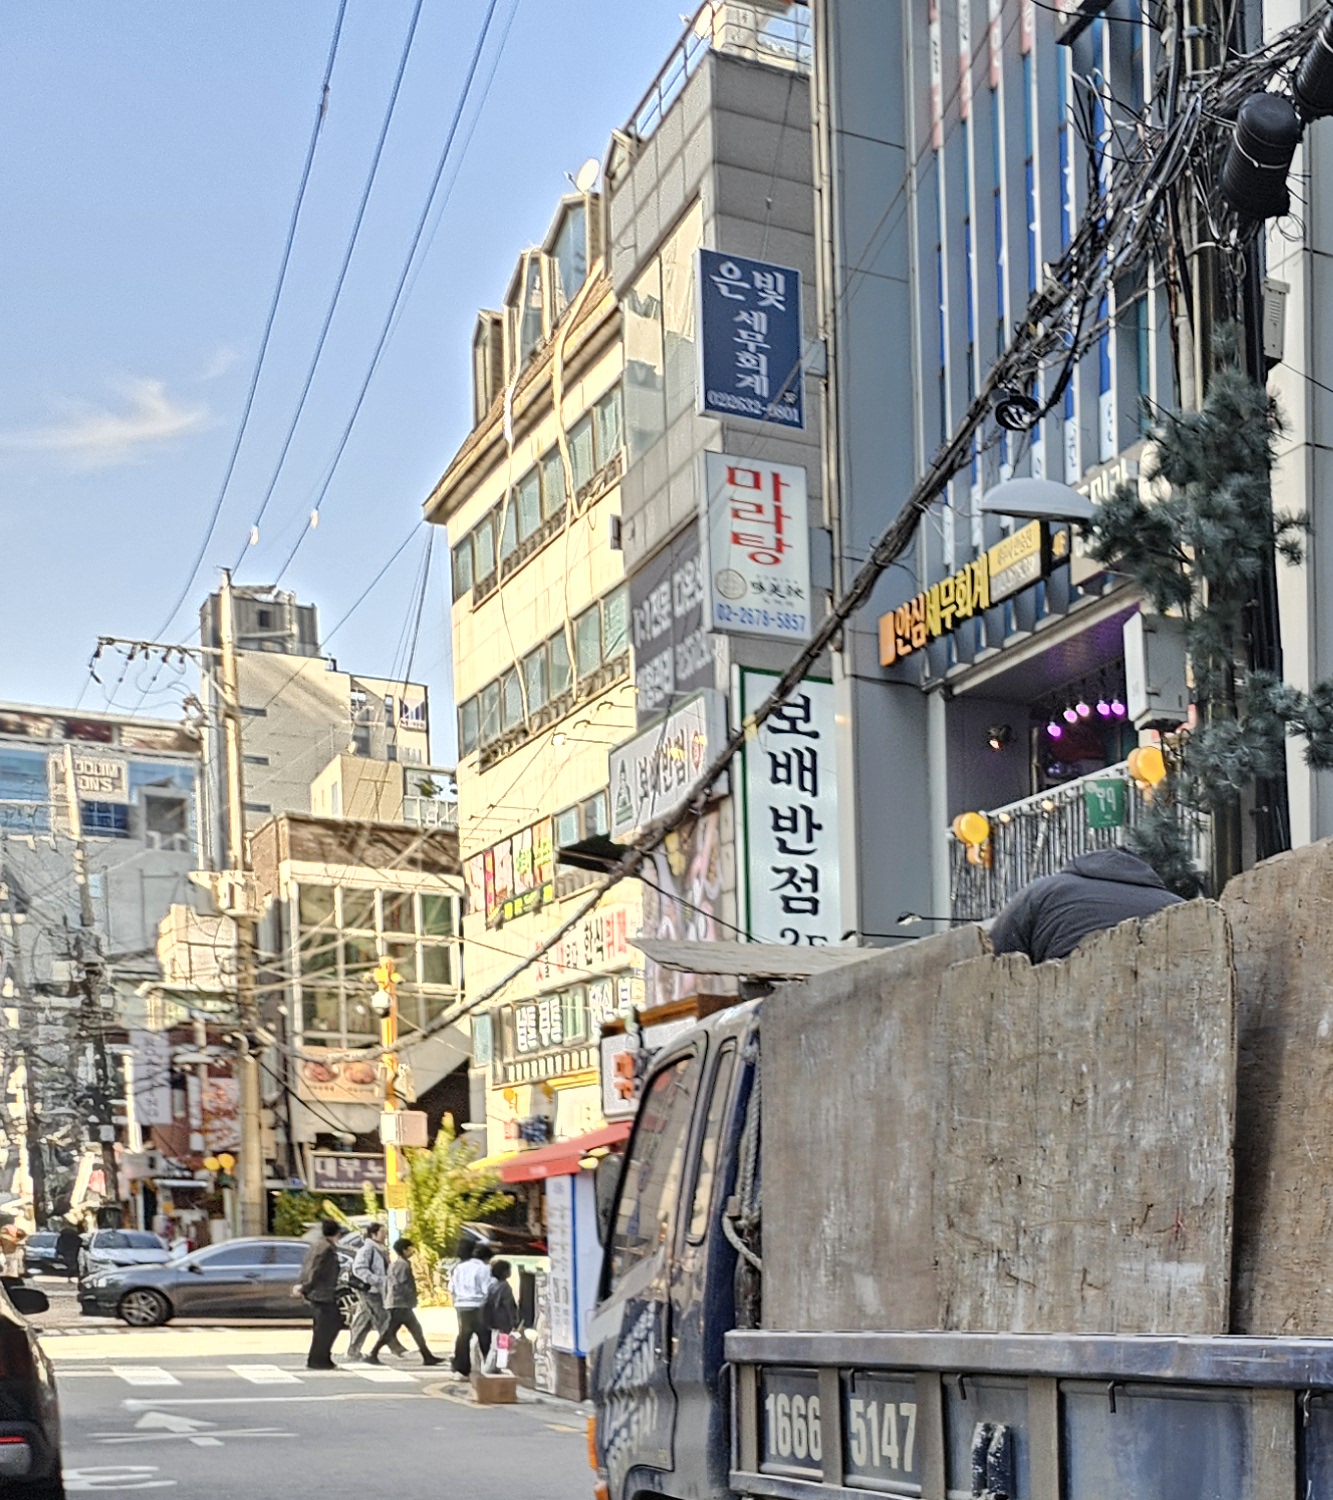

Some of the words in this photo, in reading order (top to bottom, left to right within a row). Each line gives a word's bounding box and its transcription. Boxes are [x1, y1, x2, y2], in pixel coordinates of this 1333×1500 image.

[709, 261, 786, 312] 은빛
[733, 309, 771, 399] 세무회계
[726, 464, 794, 566] 마라탕
[767, 693, 823, 916] 보배반점
[765, 1392, 822, 1461] 1666
[850, 1398, 917, 1472] 5147
